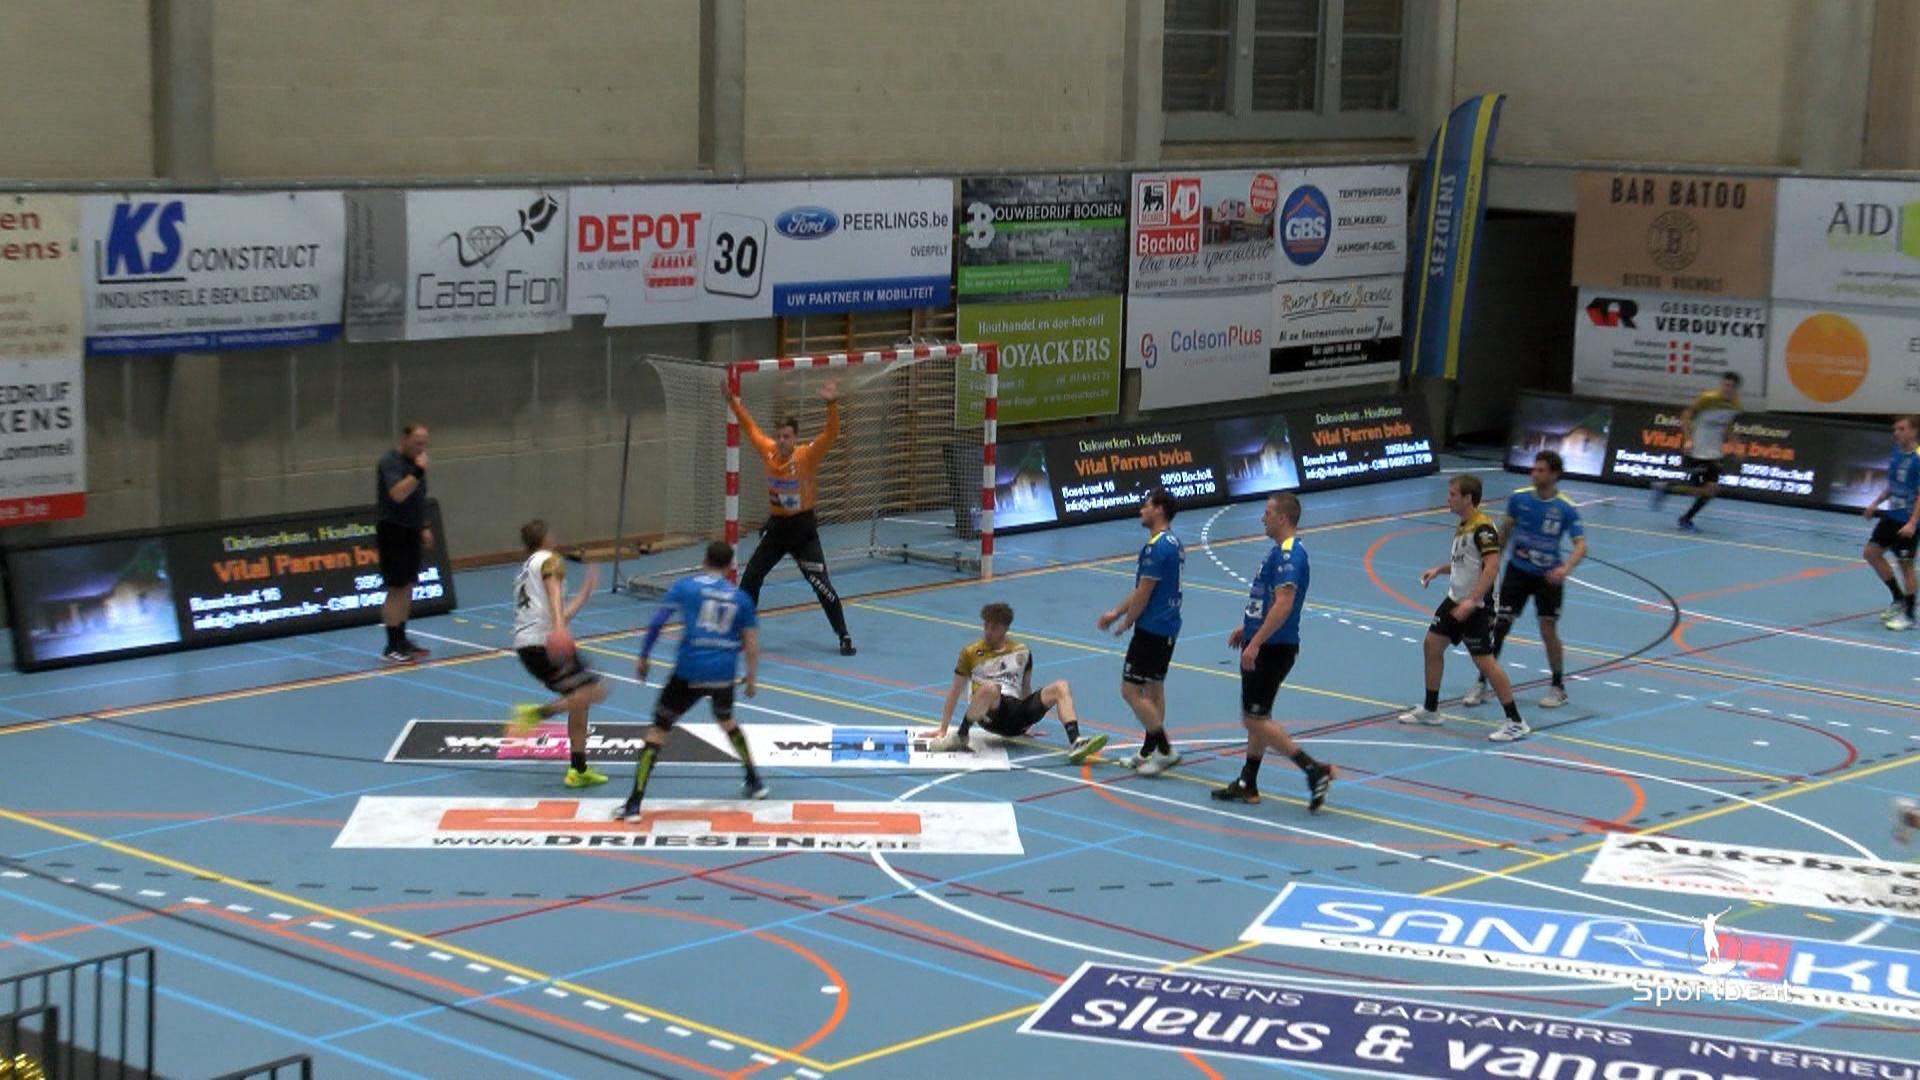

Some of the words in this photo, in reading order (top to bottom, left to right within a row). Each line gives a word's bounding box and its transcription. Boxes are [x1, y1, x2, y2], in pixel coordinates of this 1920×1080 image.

[1611, 177, 1655, 205] BAR
[1668, 180, 1747, 209] BATOO
[787, 211, 826, 235] Ford
[843, 211, 949, 231] PEERLINGS.be
[1073, 203, 1122, 219] BOONEN
[106, 201, 186, 276] KS
[577, 211, 702, 253] DEPOT
[1287, 216, 1327, 239] GBS
[713, 231, 759, 278] 30
[1138, 232, 1196, 254] Bocholt
[187, 244, 320, 272] CONSTRUCT
[97, 287, 207, 310] INDUSTRIELE
[211, 284, 320, 306] BEKLEDINGEN
[416, 272, 497, 310] Casa
[787, 293, 808, 307] UW
[809, 291, 860, 305] PARTNER
[862, 290, 875, 303] IN
[876, 287, 935, 302] MOBILITEIT
[1660, 302, 1762, 320] GEBROEDERS
[978, 319, 1036, 336] Houthandel
[1038, 320, 1050, 330] en
[1170, 325, 1263, 352] ColsonPlus
[1655, 315, 1767, 339] VERDUYCKT
[969, 337, 1111, 372] ROYACKERS
[1078, 436, 1131, 453] Dakwerken
[1136, 431, 1182, 446] Houtbouw
[1312, 428, 1341, 447] Vital
[1074, 456, 1108, 477] Vital
[1111, 452, 1159, 473] Parren
[1160, 447, 1193, 466] bvba
[212, 557, 271, 583] Vital
[1319, 936, 1467, 960] Centrale
[1105, 972, 1304, 1006] KEUKENS
[1354, 1001, 1633, 1046] BADKAMERS
[1071, 996, 1331, 1052] sleurs
[1355, 1023, 1412, 1063] &
